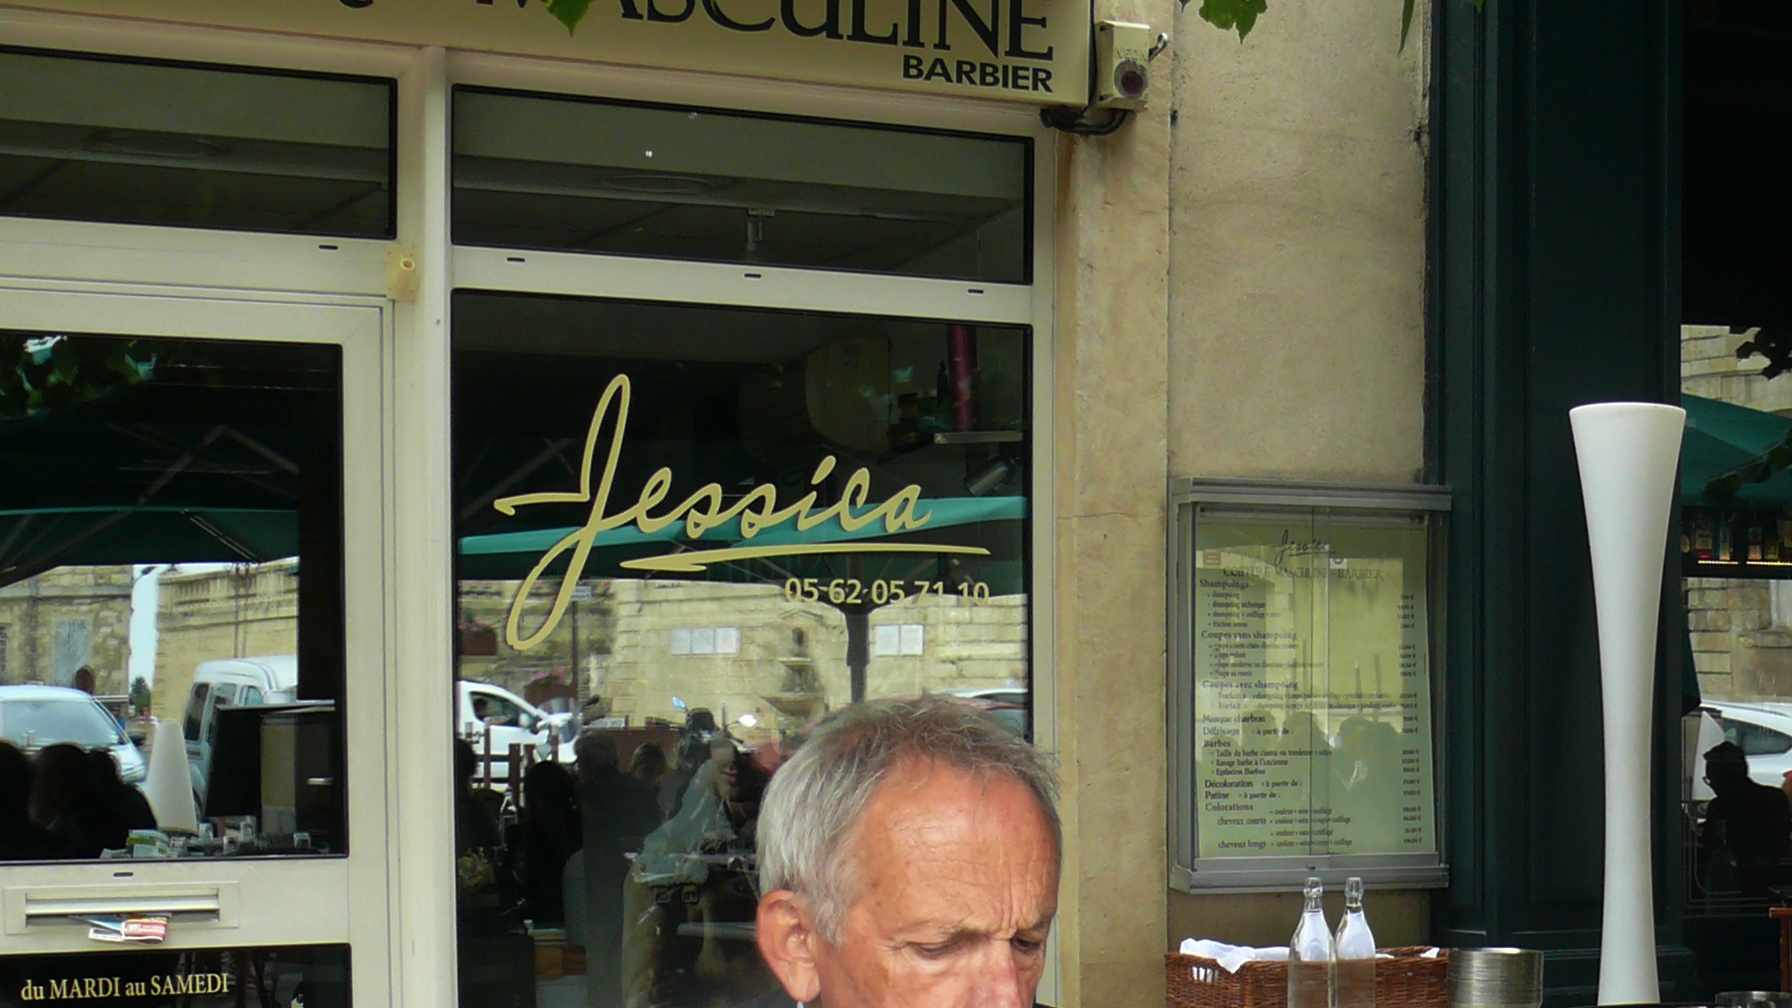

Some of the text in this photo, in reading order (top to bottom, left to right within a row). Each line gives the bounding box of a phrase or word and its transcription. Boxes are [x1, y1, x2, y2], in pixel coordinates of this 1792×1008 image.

[474, 0, 1055, 60] ULINE
[903, 55, 1054, 93] BARBIER
[494, 373, 932, 650] Jessica
[785, 578, 990, 605] 05 62 05 71 10
[1204, 791, 1230, 800] Patine
[1205, 803, 1253, 813] Colorations
[21, 973, 229, 1000] du MARDI au SAMEDI
